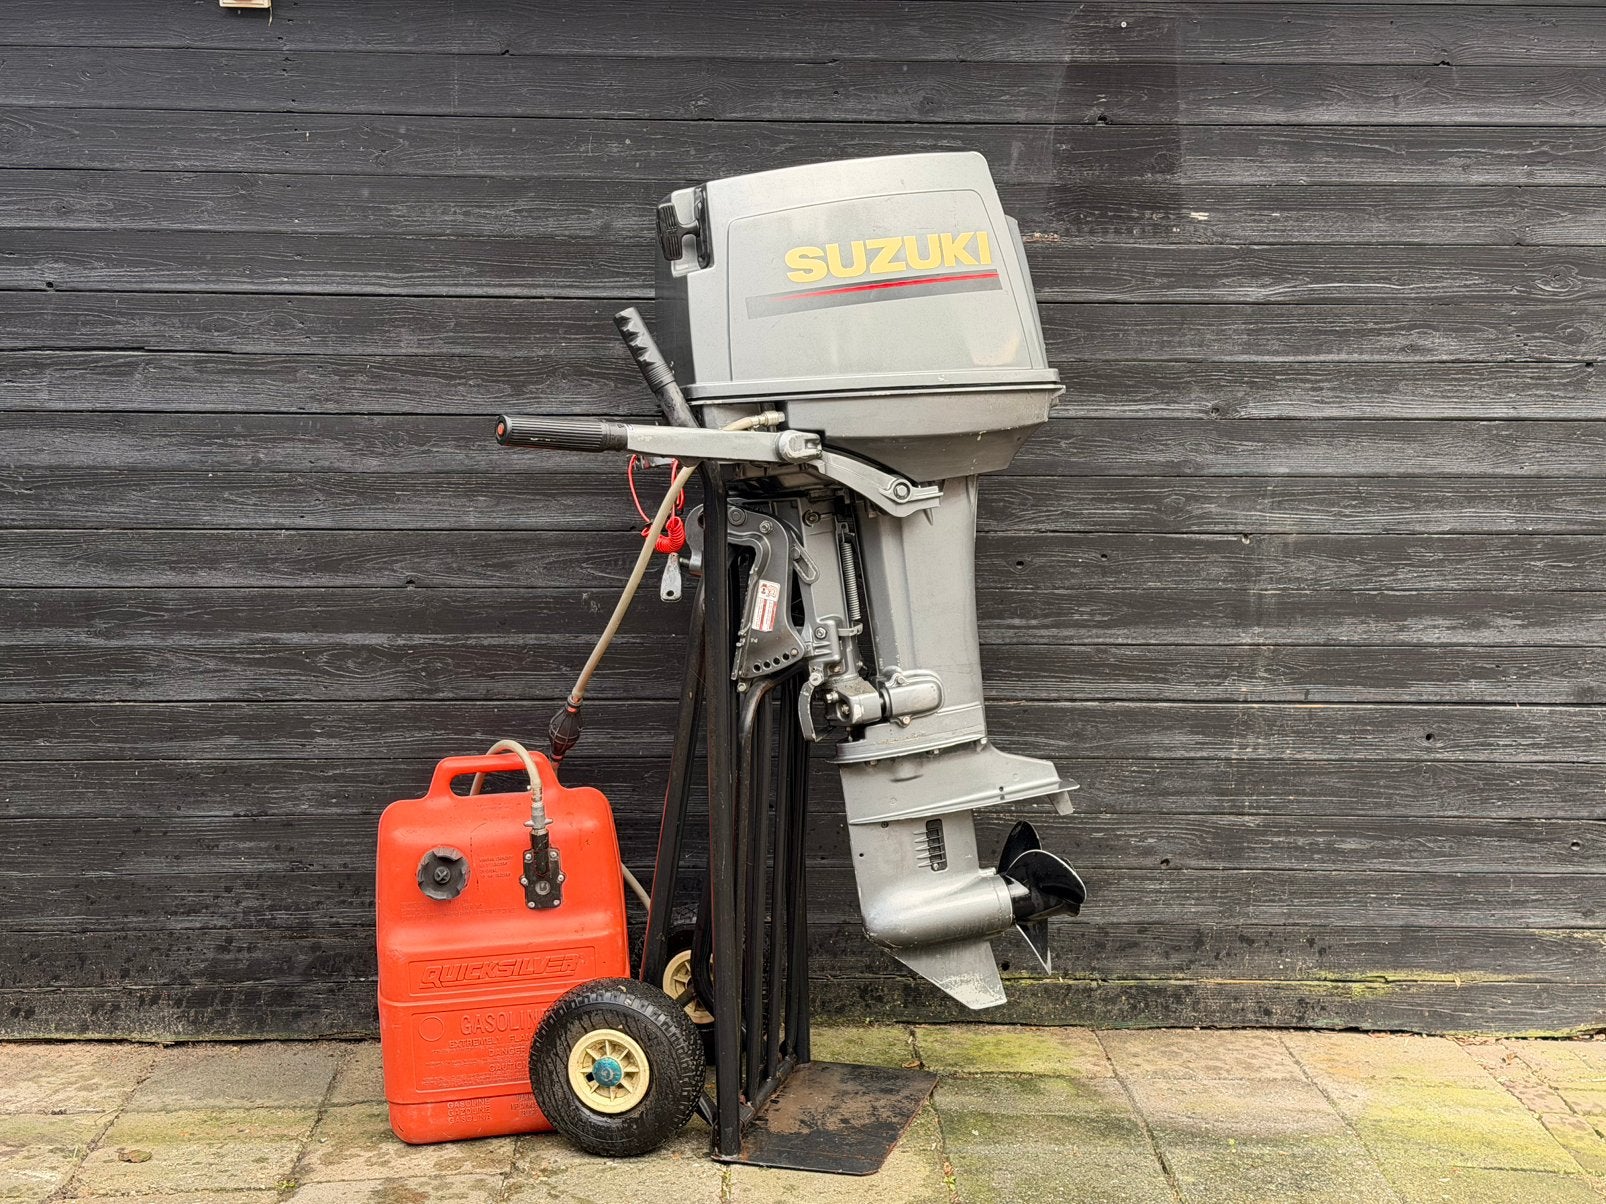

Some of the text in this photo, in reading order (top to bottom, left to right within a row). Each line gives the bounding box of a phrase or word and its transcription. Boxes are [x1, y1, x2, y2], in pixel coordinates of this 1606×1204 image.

[784, 231, 992, 283] SUZUKI
[419, 953, 581, 989] QUICKSILVER
[448, 1035, 503, 1048] EXTREMELY
[488, 1045, 527, 1057] DANGER
[447, 1098, 491, 1109] GASOLINE
